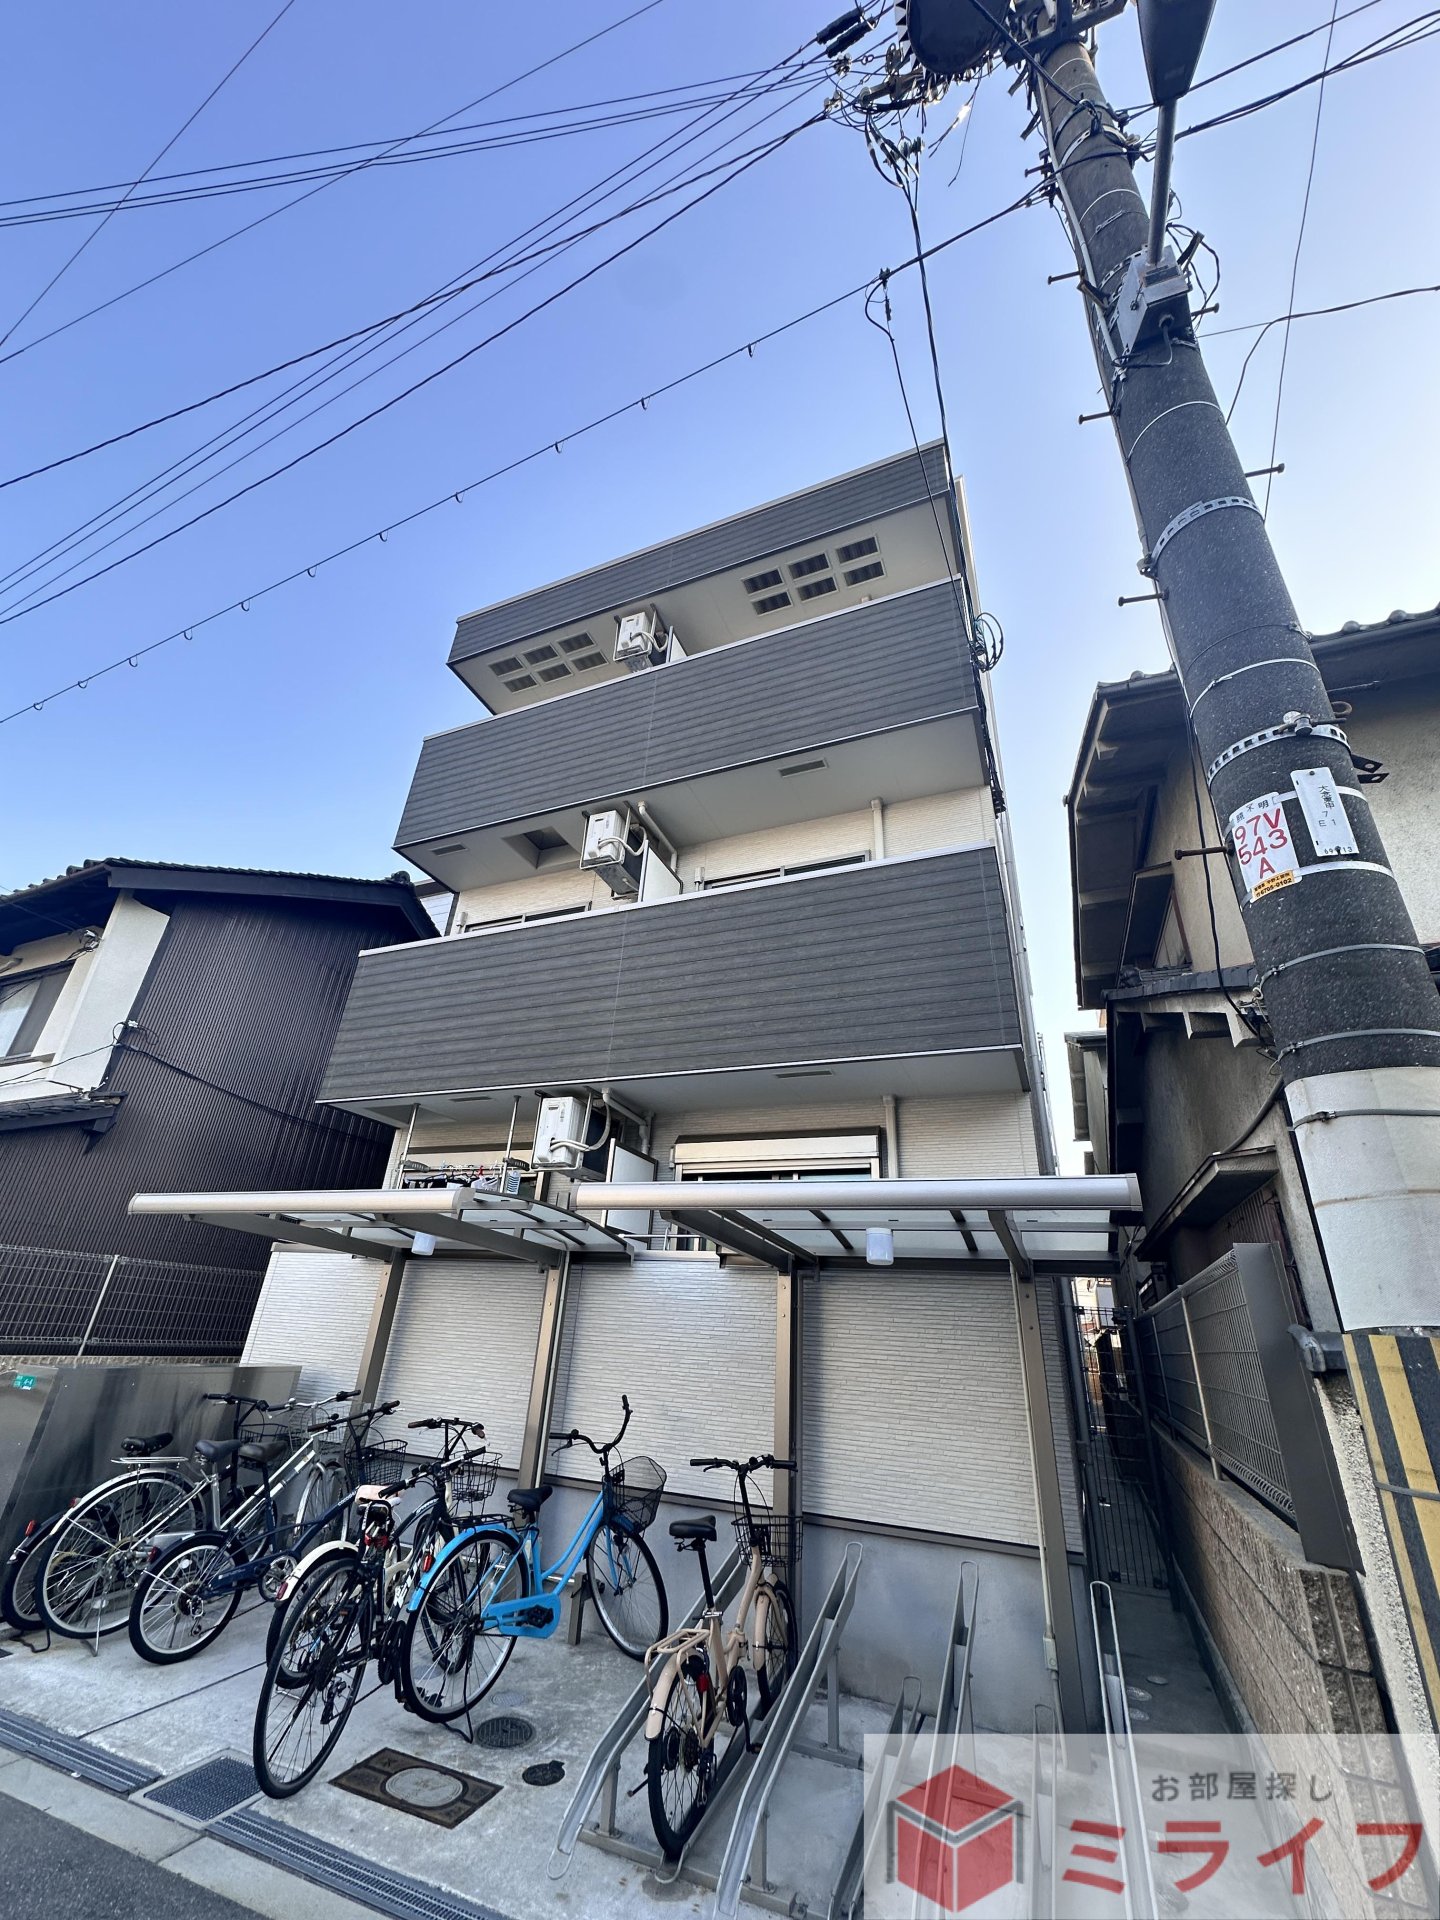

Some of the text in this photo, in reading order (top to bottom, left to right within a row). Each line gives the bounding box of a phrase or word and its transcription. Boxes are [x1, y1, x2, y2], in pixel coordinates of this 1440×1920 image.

[1234, 808, 1281, 845] 97V
[1237, 829, 1288, 865] 543
[1259, 856, 1276, 879] A
